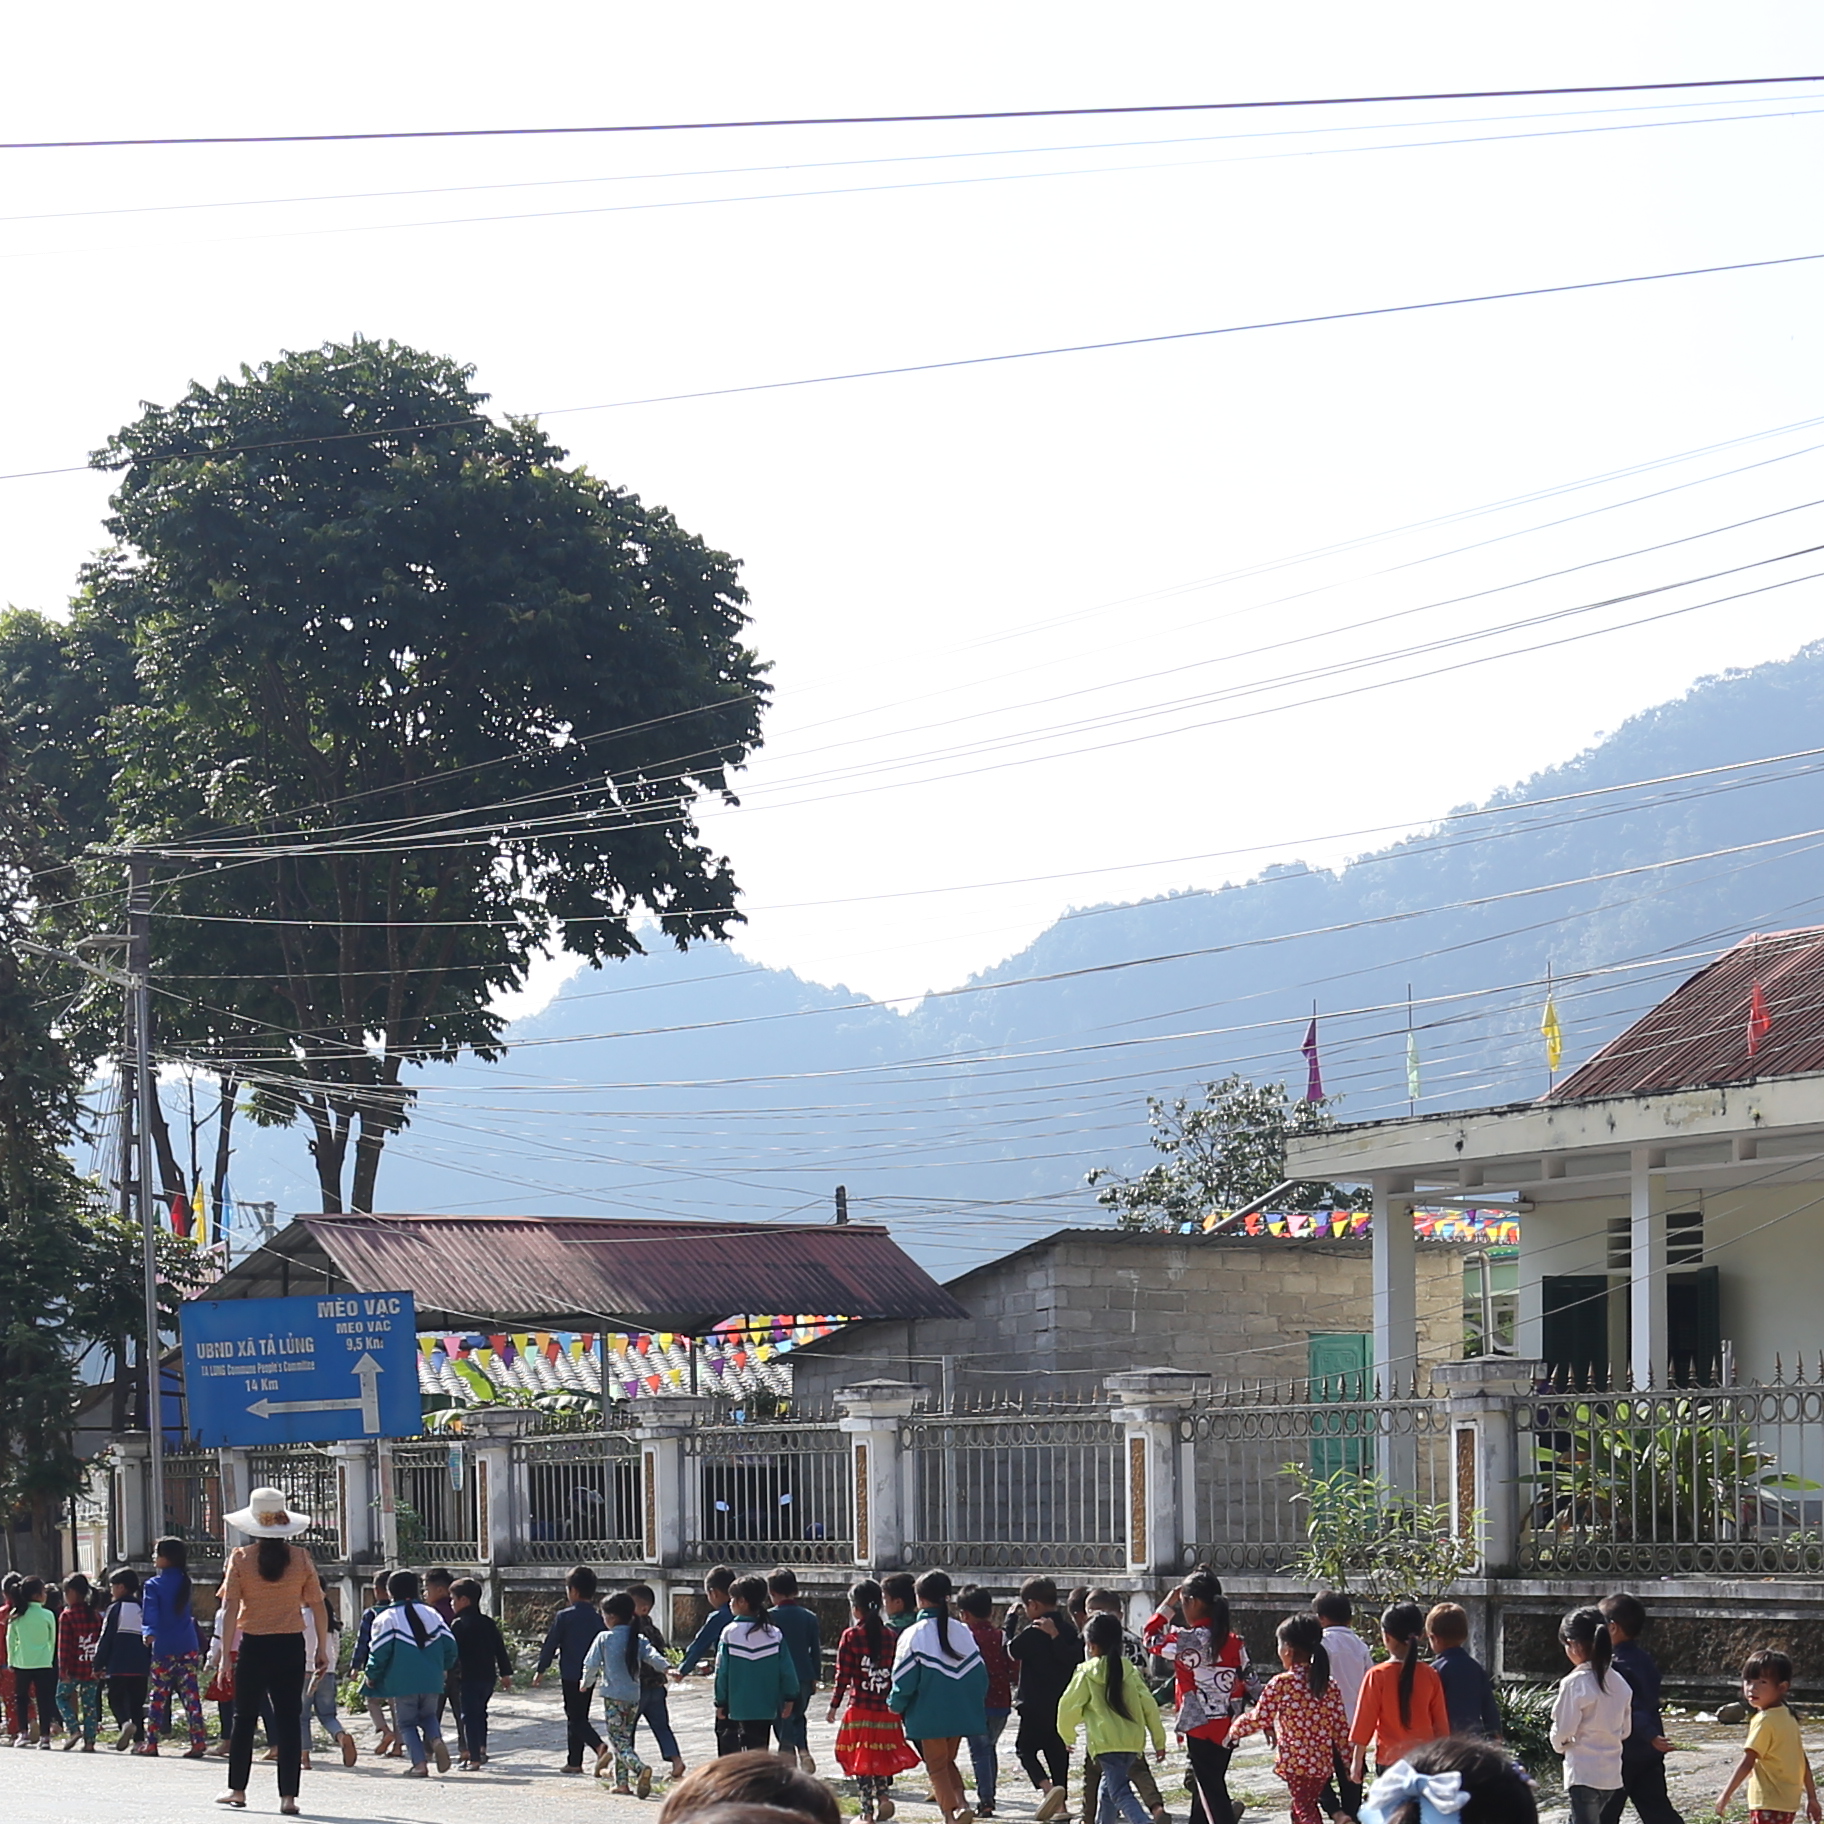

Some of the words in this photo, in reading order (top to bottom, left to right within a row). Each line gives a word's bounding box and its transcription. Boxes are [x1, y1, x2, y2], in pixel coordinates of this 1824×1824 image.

[317, 1297, 359, 1318] MÈO
[364, 1298, 401, 1318] VẠC
[336, 1321, 364, 1334] MEO
[367, 1320, 392, 1332] VAC
[196, 1342, 234, 1359] UBND
[237, 1337, 257, 1357] XÃ
[259, 1333, 276, 1356] TẢ
[279, 1332, 314, 1354] LỦNG
[345, 1337, 363, 1351] 9,5
[245, 1379, 258, 1392] 14
[260, 1378, 279, 1391] Km
